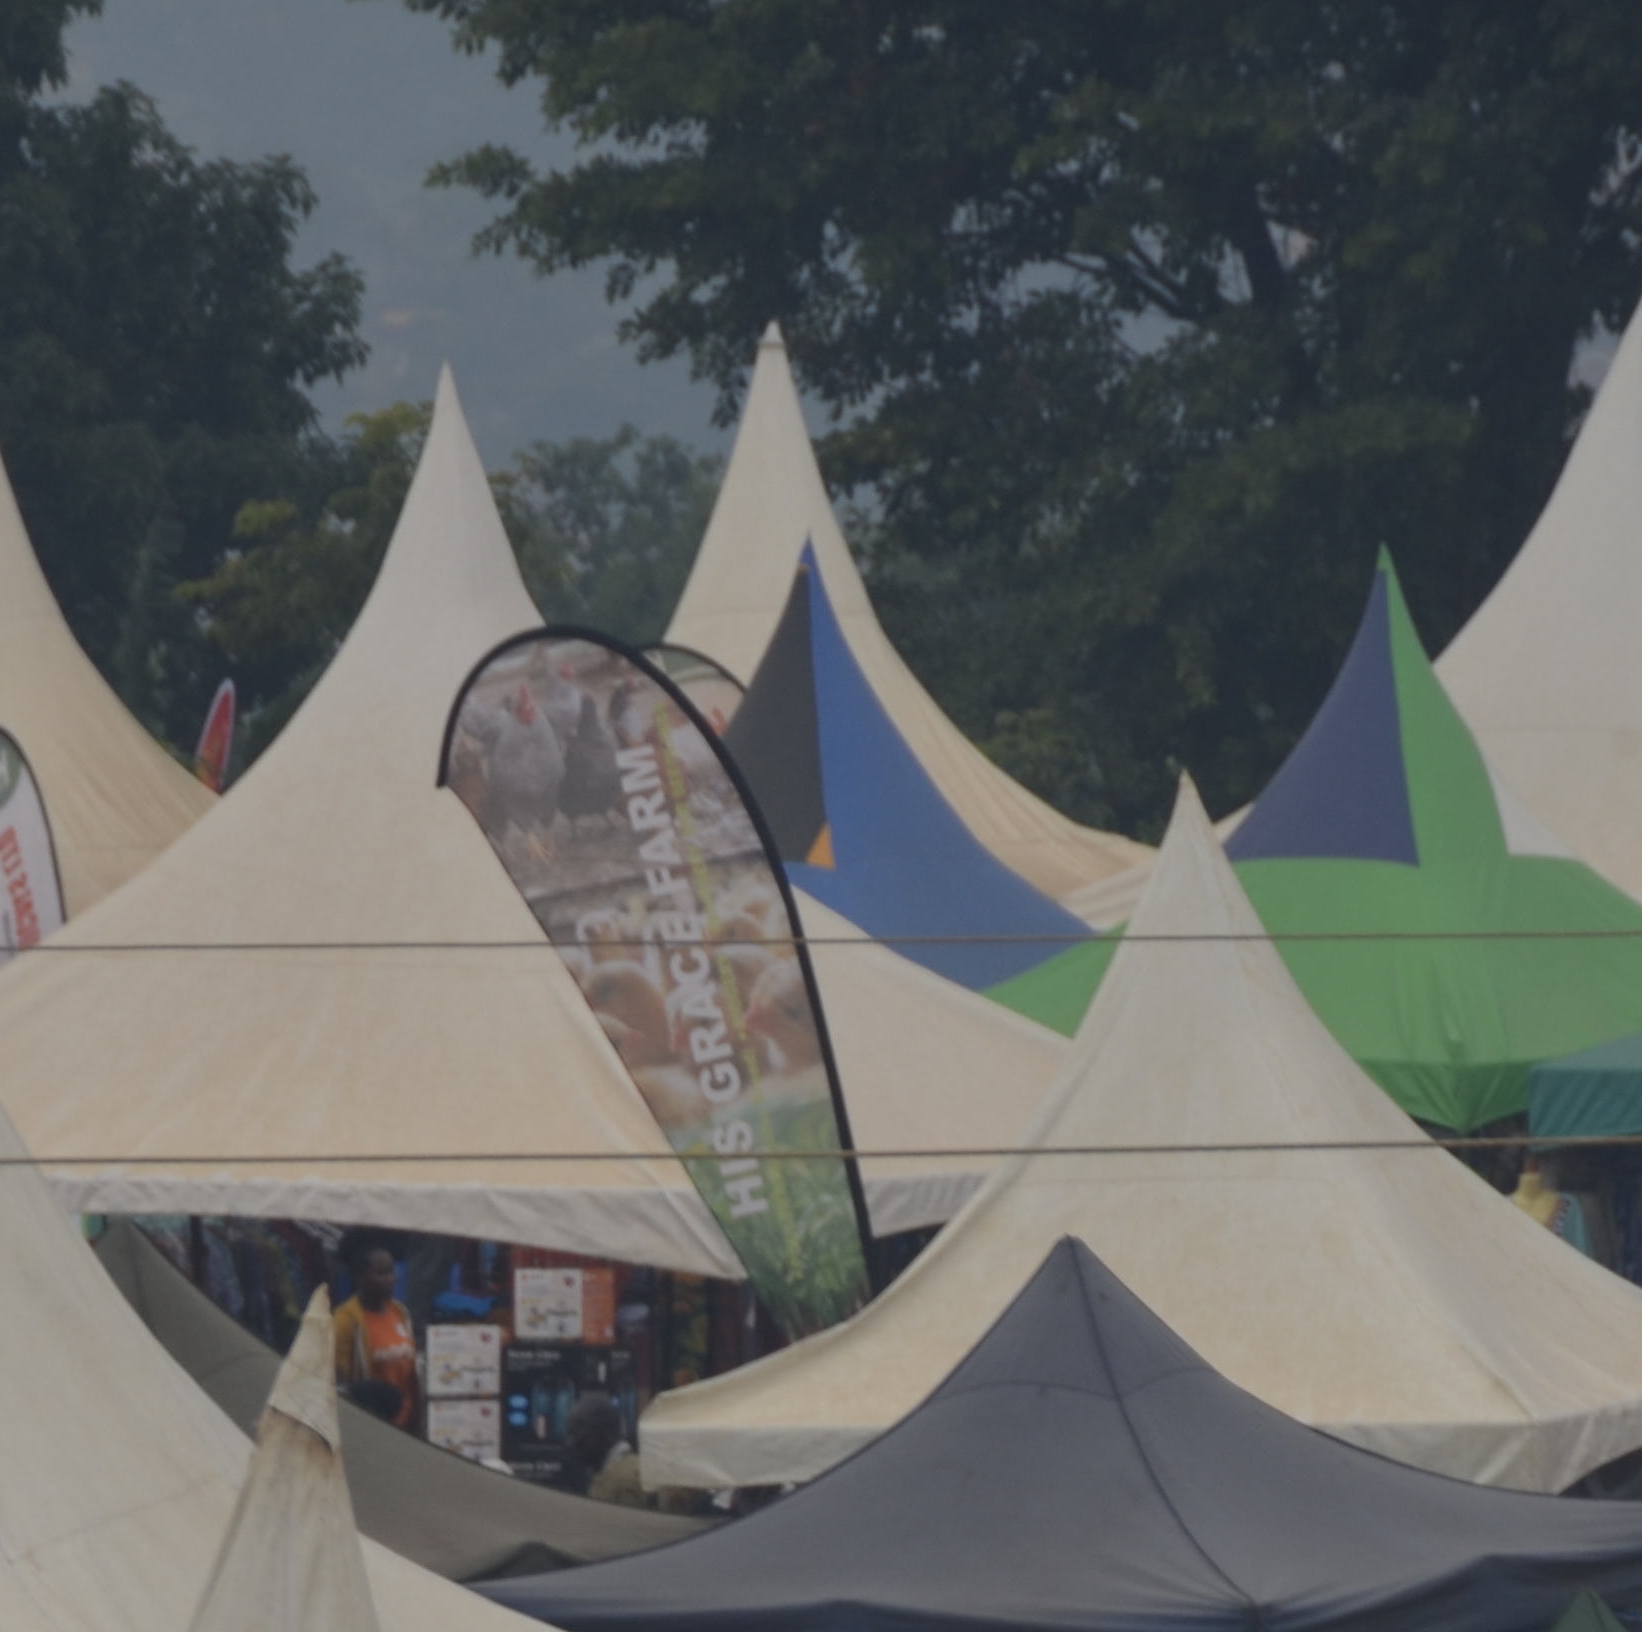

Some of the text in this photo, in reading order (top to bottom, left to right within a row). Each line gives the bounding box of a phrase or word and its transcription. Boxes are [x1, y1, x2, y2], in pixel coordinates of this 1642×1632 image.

[614, 743, 690, 897] FARM
[658, 911, 742, 1102] GRACE
[711, 1118, 769, 1218] HIS
